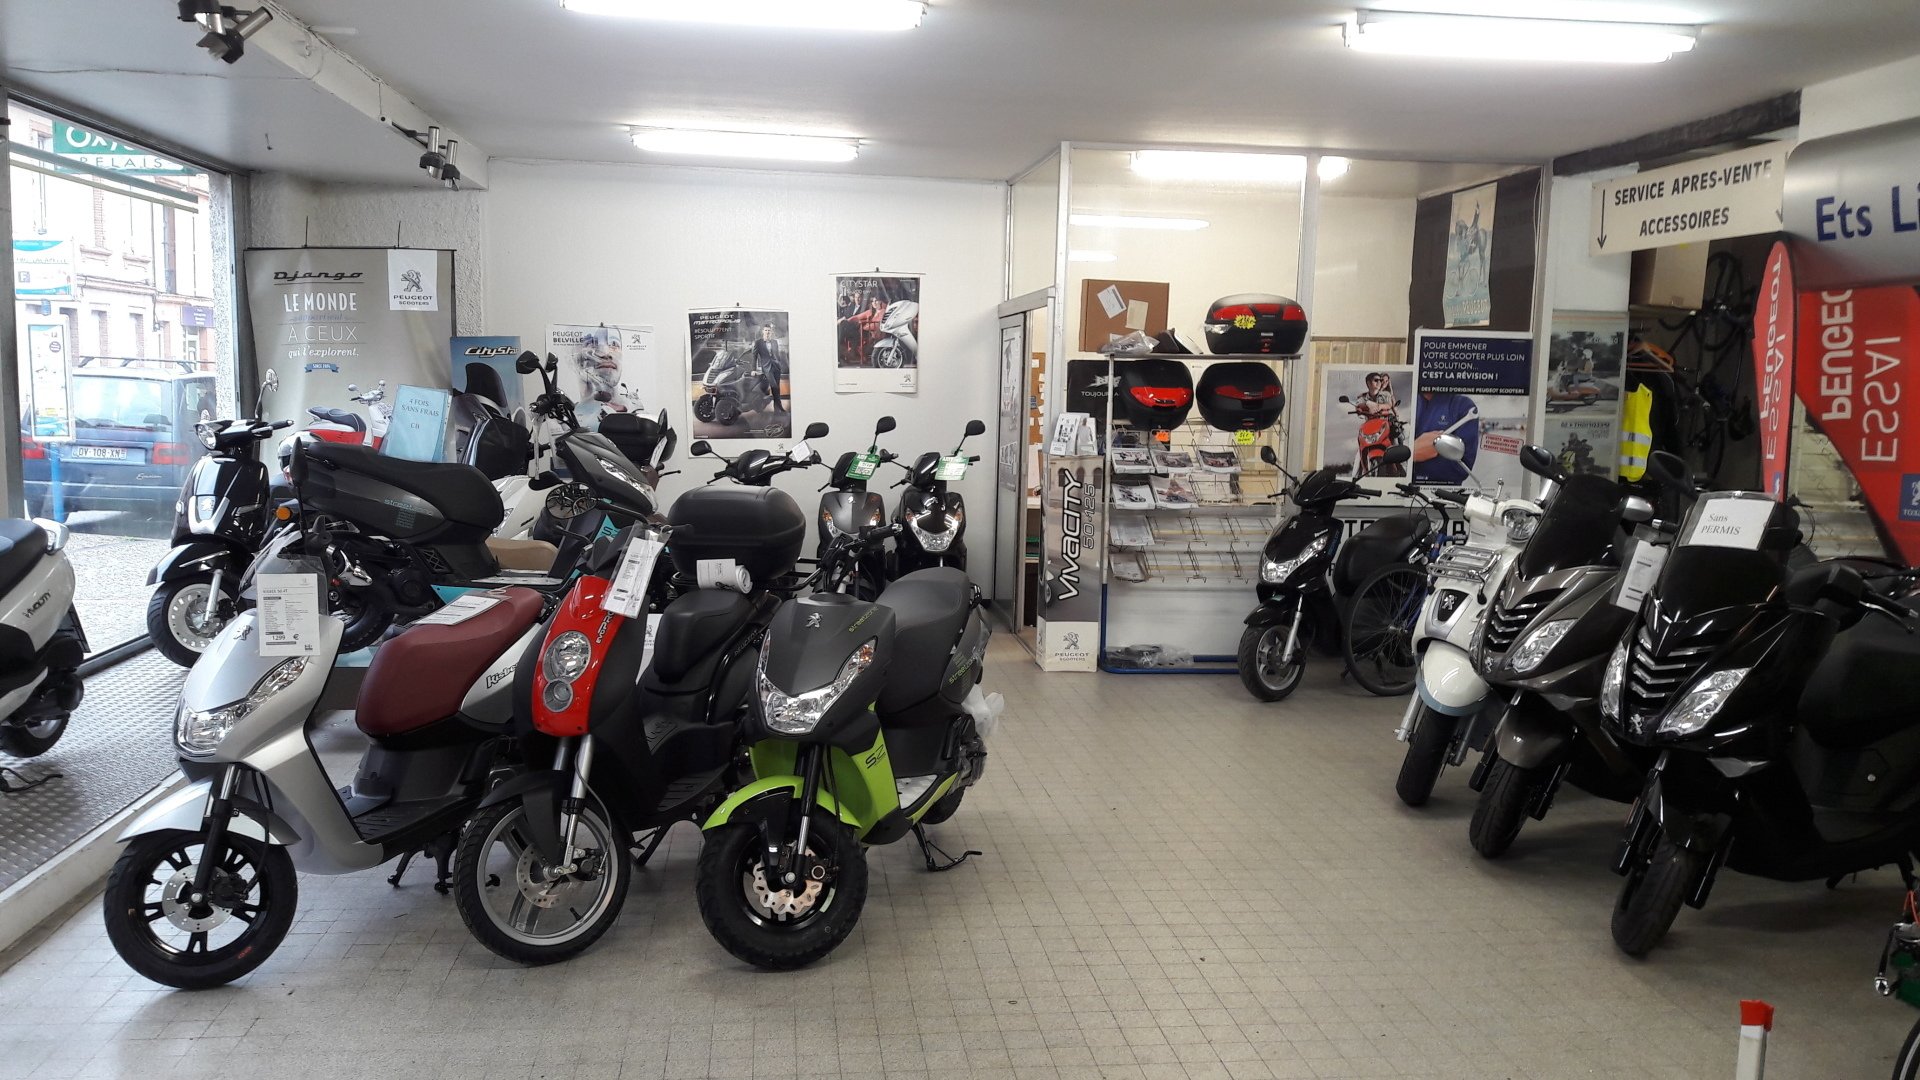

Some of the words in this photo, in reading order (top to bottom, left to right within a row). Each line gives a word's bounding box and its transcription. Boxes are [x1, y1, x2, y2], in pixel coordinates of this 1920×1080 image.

[1615, 181, 1664, 206] SERVICE
[1671, 159, 1772, 196] APRES-VENTE
[1639, 207, 1730, 237] ACCESSOIRES
[1816, 196, 1872, 242] Ets
[273, 270, 363, 282] Django
[840, 279, 878, 288] CITYSTAR
[284, 293, 299, 312] LE
[304, 292, 357, 311] MONDE
[304, 325, 358, 341] CEUX
[1424, 341, 1446, 350] POUR
[1448, 342, 1488, 351] EMMENER
[288, 348, 300, 359] qui
[1423, 351, 1448, 359] VOTRE
[1450, 352, 1485, 361] SCOOTER
[1487, 353, 1505, 361] PLUS
[1506, 353, 1525, 362] LOIN
[1423, 361, 1433, 369] LA
[1434, 362, 1479, 370] SOLUTION...
[1422, 371, 1443, 379] C'EST
[1445, 371, 1455, 379] LA
[1456, 370, 1494, 380] RÉVISION
[401, 404, 419, 413] SANS
[420, 408, 440, 417] FRAIS
[1708, 513, 1728, 522] Sans
[1700, 525, 1741, 536] PERMIS
